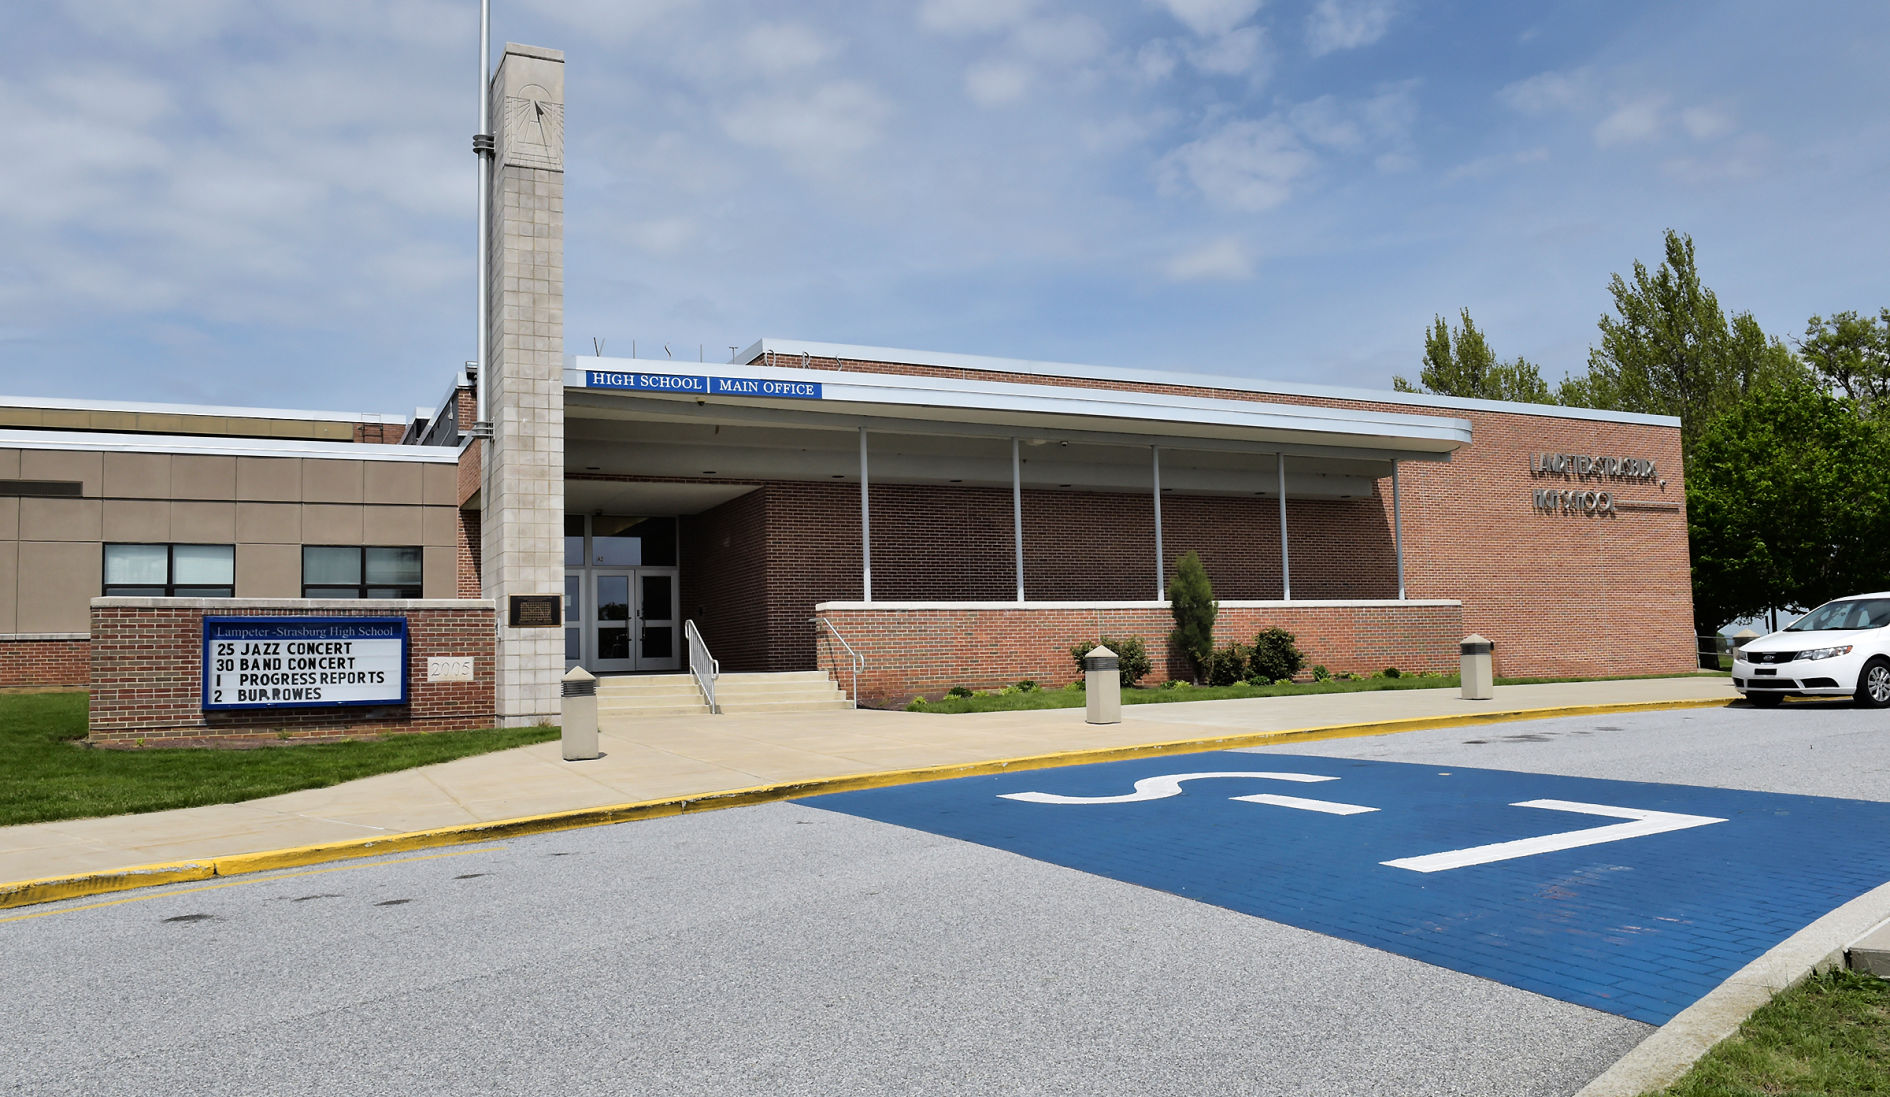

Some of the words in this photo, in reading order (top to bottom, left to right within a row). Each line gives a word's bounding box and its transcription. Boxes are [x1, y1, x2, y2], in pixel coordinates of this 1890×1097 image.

[593, 372, 635, 386] HIGH
[640, 375, 702, 389] SCHOOL
[720, 379, 758, 392] MAIN
[763, 382, 814, 395] OFFICE
[330, 626, 355, 638] High
[358, 626, 393, 636] School
[217, 643, 235, 656] 25
[240, 642, 280, 655] JAZZ
[287, 642, 352, 655] CONCERT
[216, 658, 234, 671] 30
[240, 658, 281, 671] BAND
[288, 657, 355, 671] CONCERT
[431, 661, 470, 676] 2005
[240, 672, 317, 686] PROGRESS
[320, 671, 385, 684] REPORTS
[214, 690, 223, 702] 2
[238, 687, 321, 701] BURROWES
